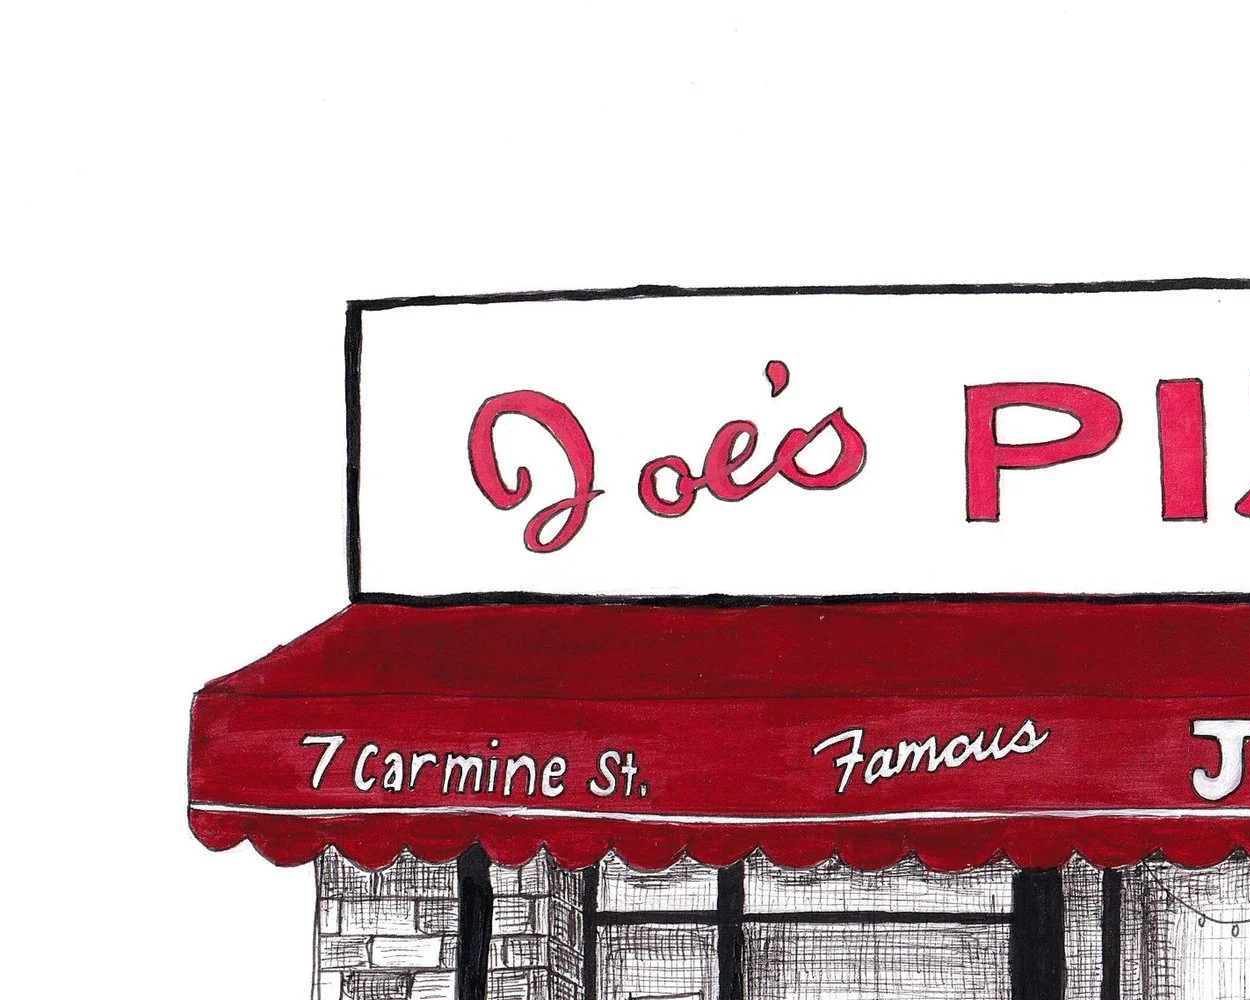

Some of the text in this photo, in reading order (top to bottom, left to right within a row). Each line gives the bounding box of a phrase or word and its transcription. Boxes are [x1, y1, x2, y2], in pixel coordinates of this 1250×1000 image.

[468, 360, 867, 553] Joe's
[302, 733, 345, 789] 7
[588, 750, 650, 798] St.
[813, 718, 1052, 794] Famous
